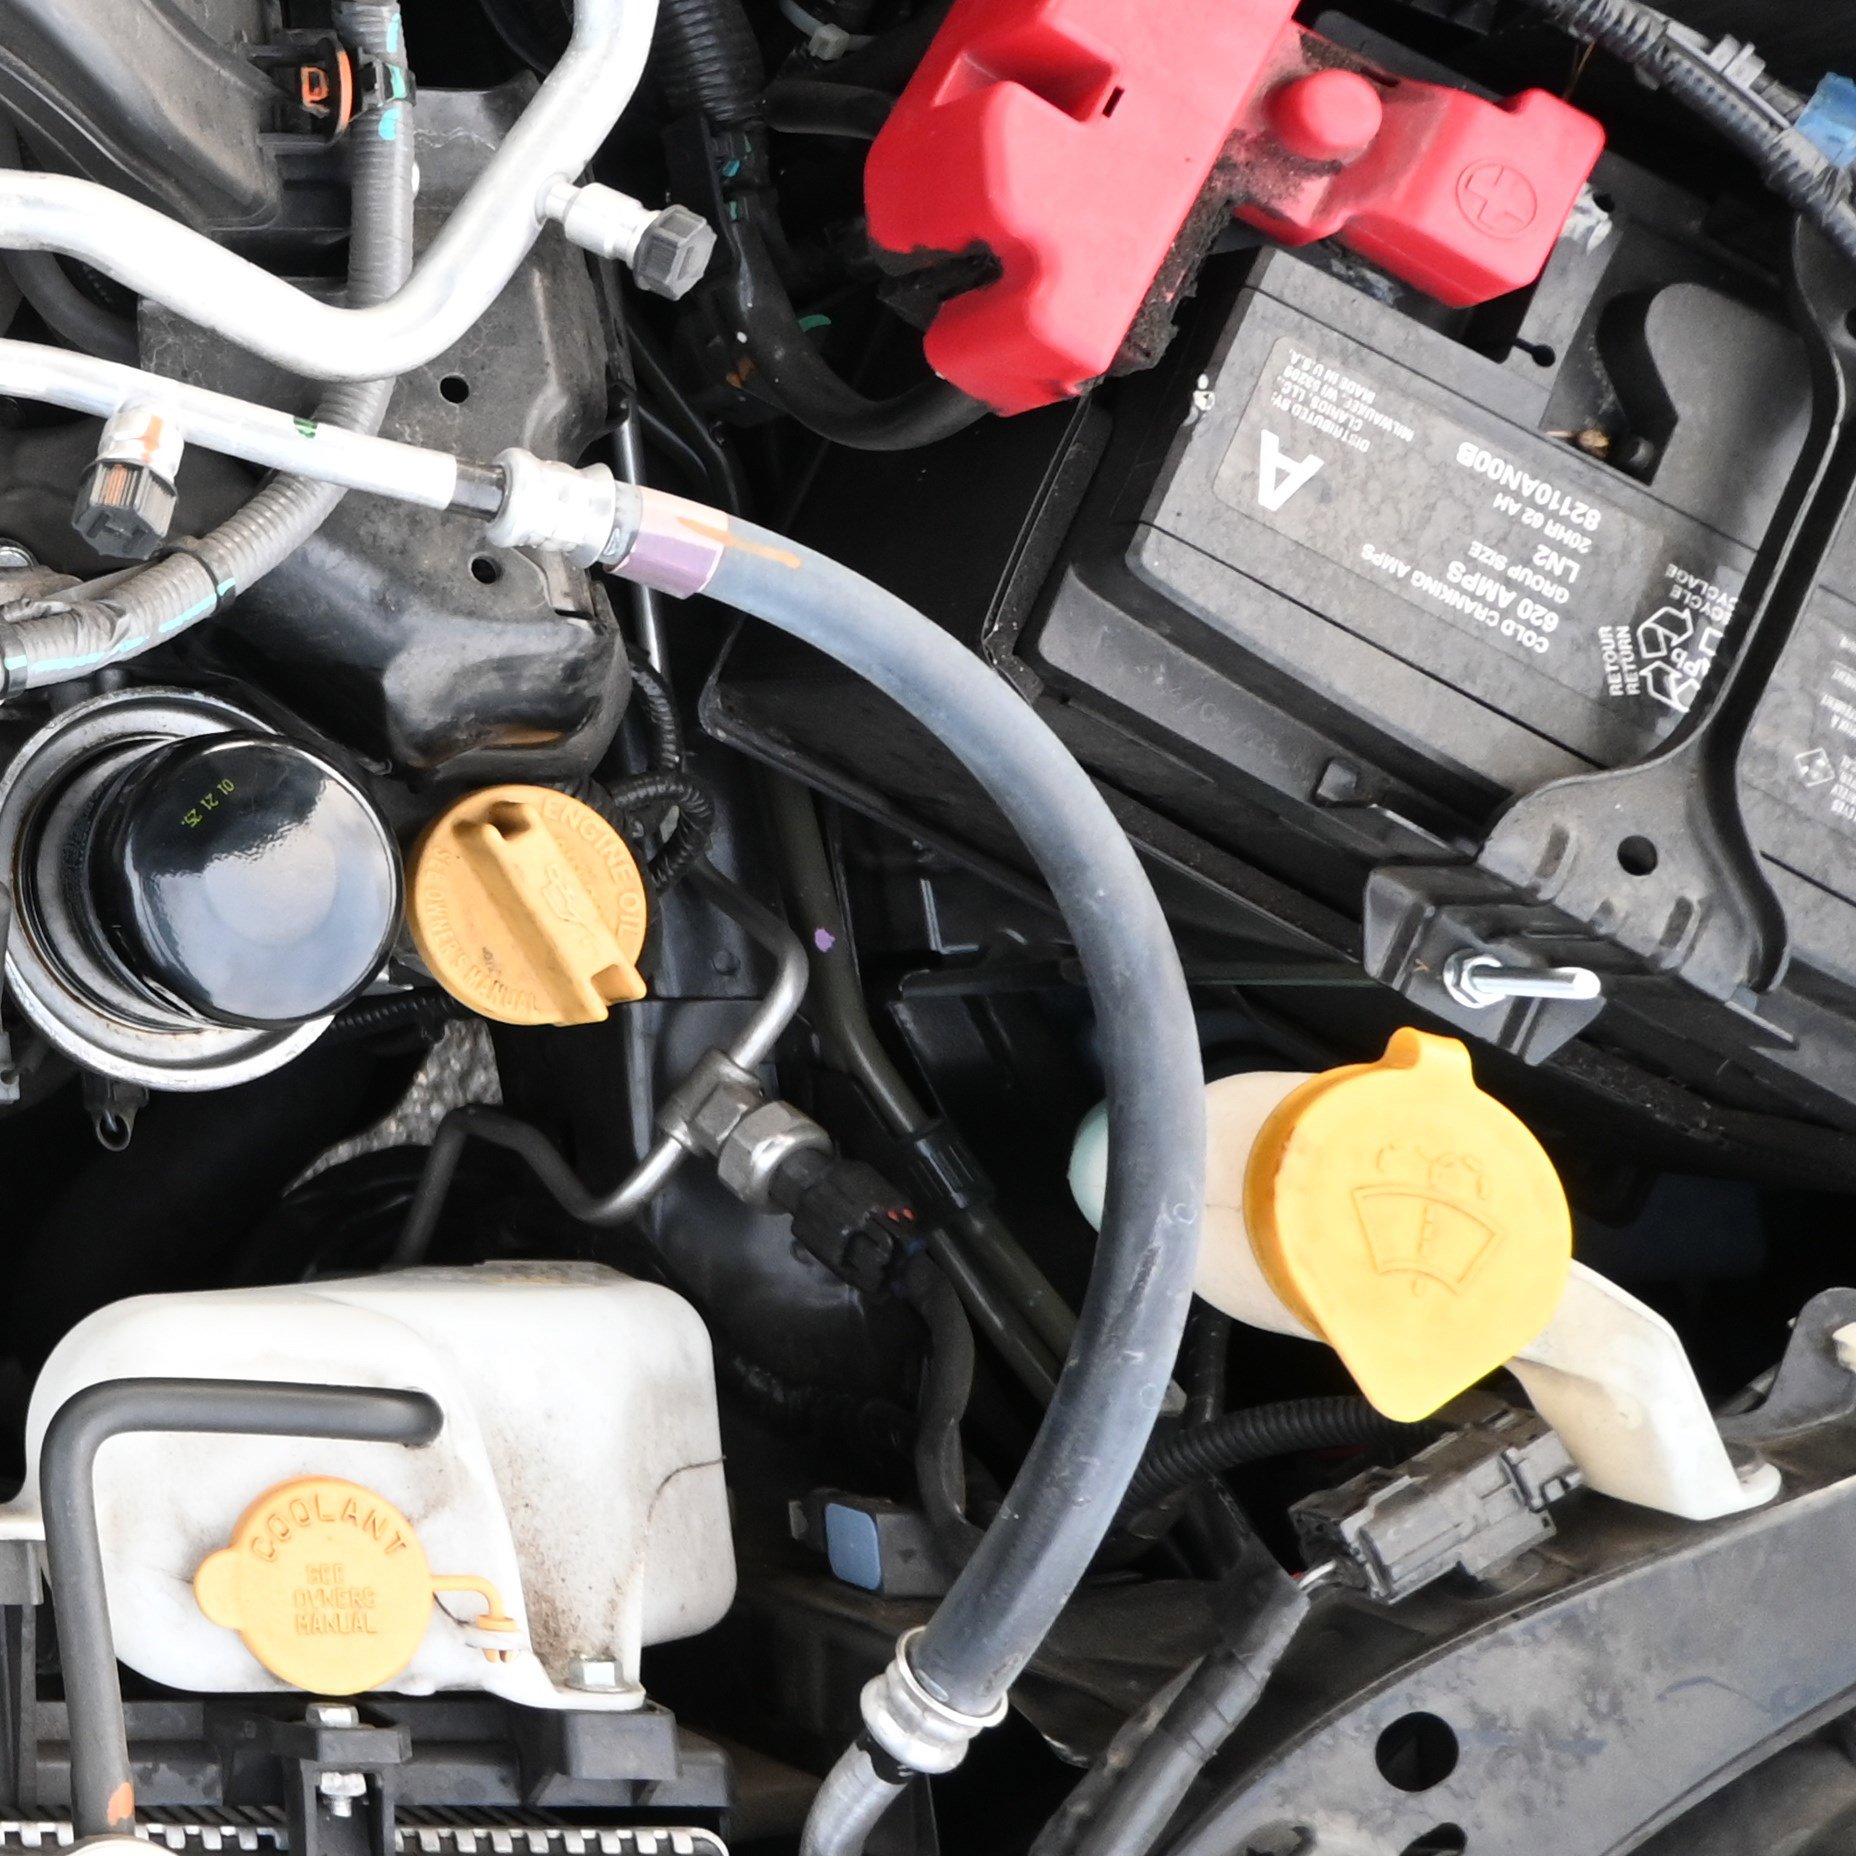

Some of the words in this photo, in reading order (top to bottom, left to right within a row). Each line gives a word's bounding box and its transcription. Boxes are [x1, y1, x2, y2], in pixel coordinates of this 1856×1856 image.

[1271, 391, 1292, 413] BY:
[1339, 374, 1376, 404] MADE
[1291, 404, 1371, 453] DISTRIBUTED
[1258, 429, 1325, 512] A
[1457, 441, 1601, 531] 82110AN00B
[1493, 492, 1522, 516] AH
[1521, 506, 1544, 528] 62
[1543, 519, 1592, 554] 20HR
[1361, 544, 1411, 578] AMPS
[1468, 540, 1508, 571] SIZE
[1532, 544, 1580, 583] LN2
[1410, 570, 1500, 627] CRANKING
[1446, 560, 1517, 609] AMPS
[1507, 564, 1570, 604] GROUP
[1665, 563, 1738, 611] CYCLAGE
[1516, 598, 1559, 632] 620
[1669, 584, 1733, 625] ECYCLE
[1500, 618, 1549, 654] COLD
[1598, 625, 1625, 696] RETOUR
[1616, 625, 1641, 696] RETURN
[200, 792, 219, 811] 21
[216, 778, 235, 796] 01
[542, 795, 635, 885] ENGINE
[616, 891, 642, 940] OIL
[464, 964, 541, 1013] MANUAL
[251, 1494, 407, 1563] COOLANT
[305, 1563, 346, 1585] SEE
[293, 1587, 377, 1609] OWNERS
[295, 1612, 378, 1635] MANUAL
